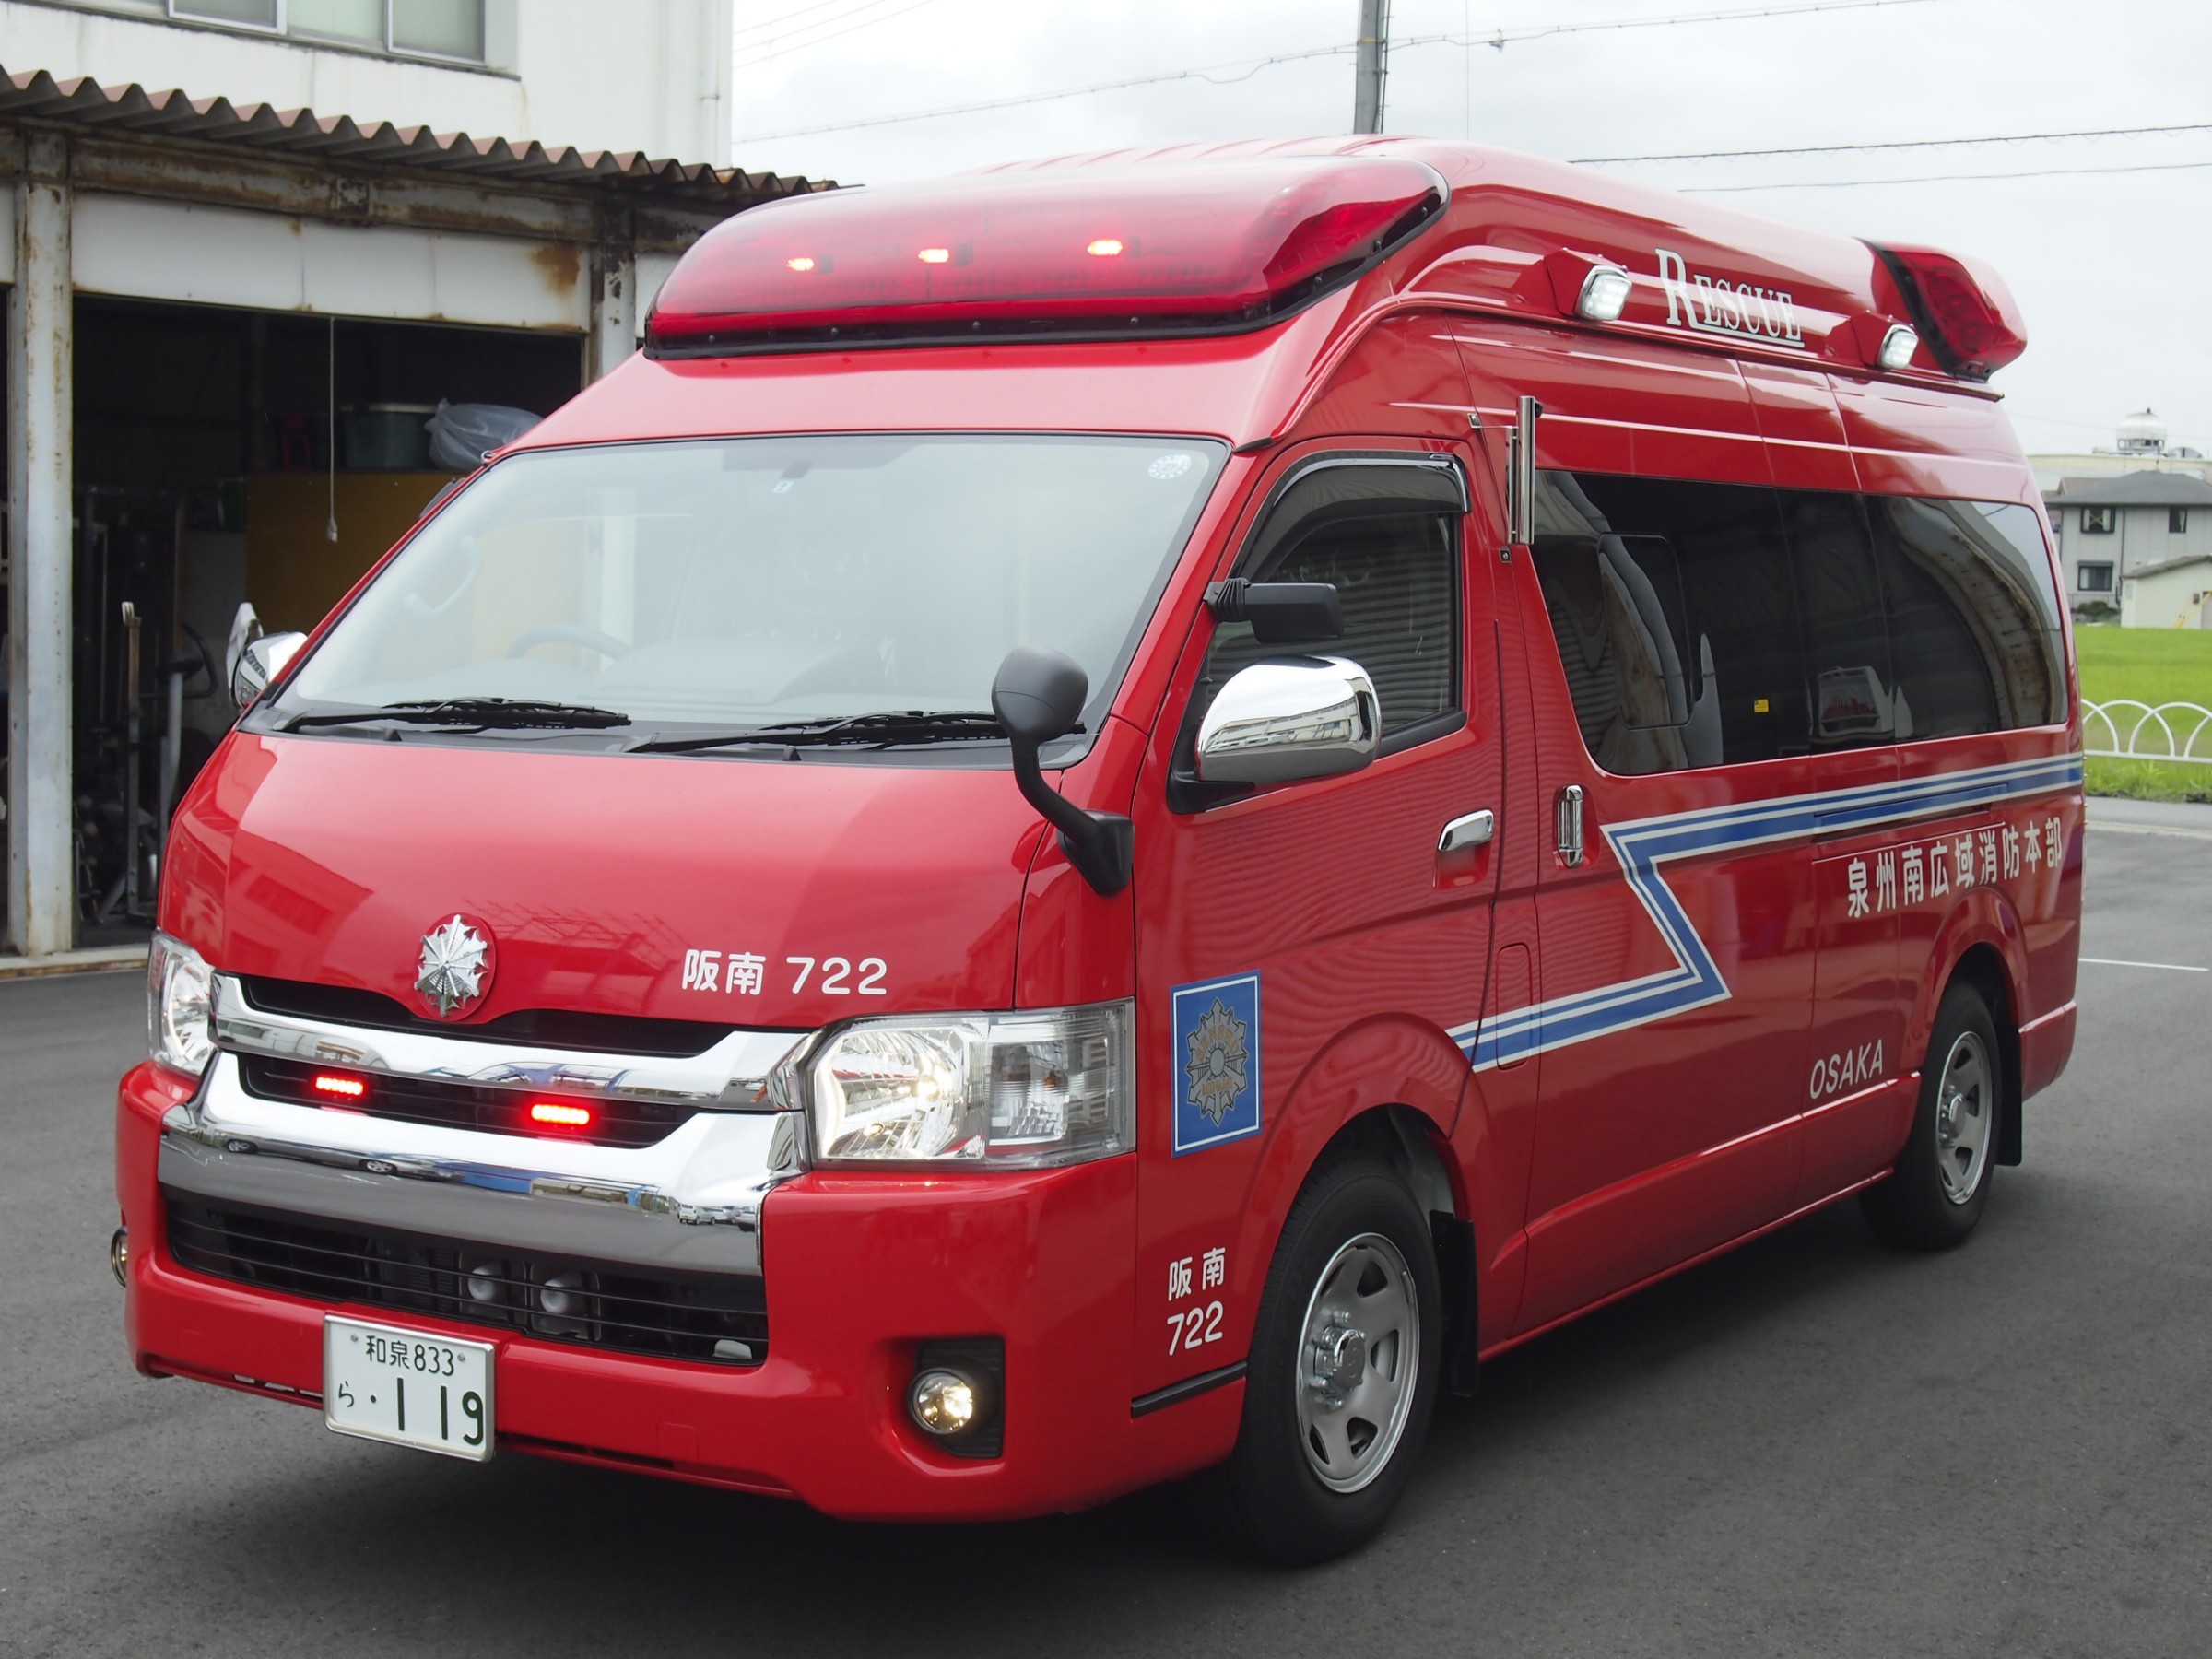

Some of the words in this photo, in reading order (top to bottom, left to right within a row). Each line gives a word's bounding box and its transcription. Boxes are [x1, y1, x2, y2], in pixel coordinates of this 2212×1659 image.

[1655, 248, 1804, 347] RESCUE
[1847, 816, 2063, 919] 泉州南広域消防本部
[682, 949, 766, 995] 阪南
[786, 957, 887, 995] 722
[1809, 1039, 1884, 1100] OSAKA
[1168, 1247, 1226, 1301] 阪南
[1167, 1300, 1224, 1357] 722
